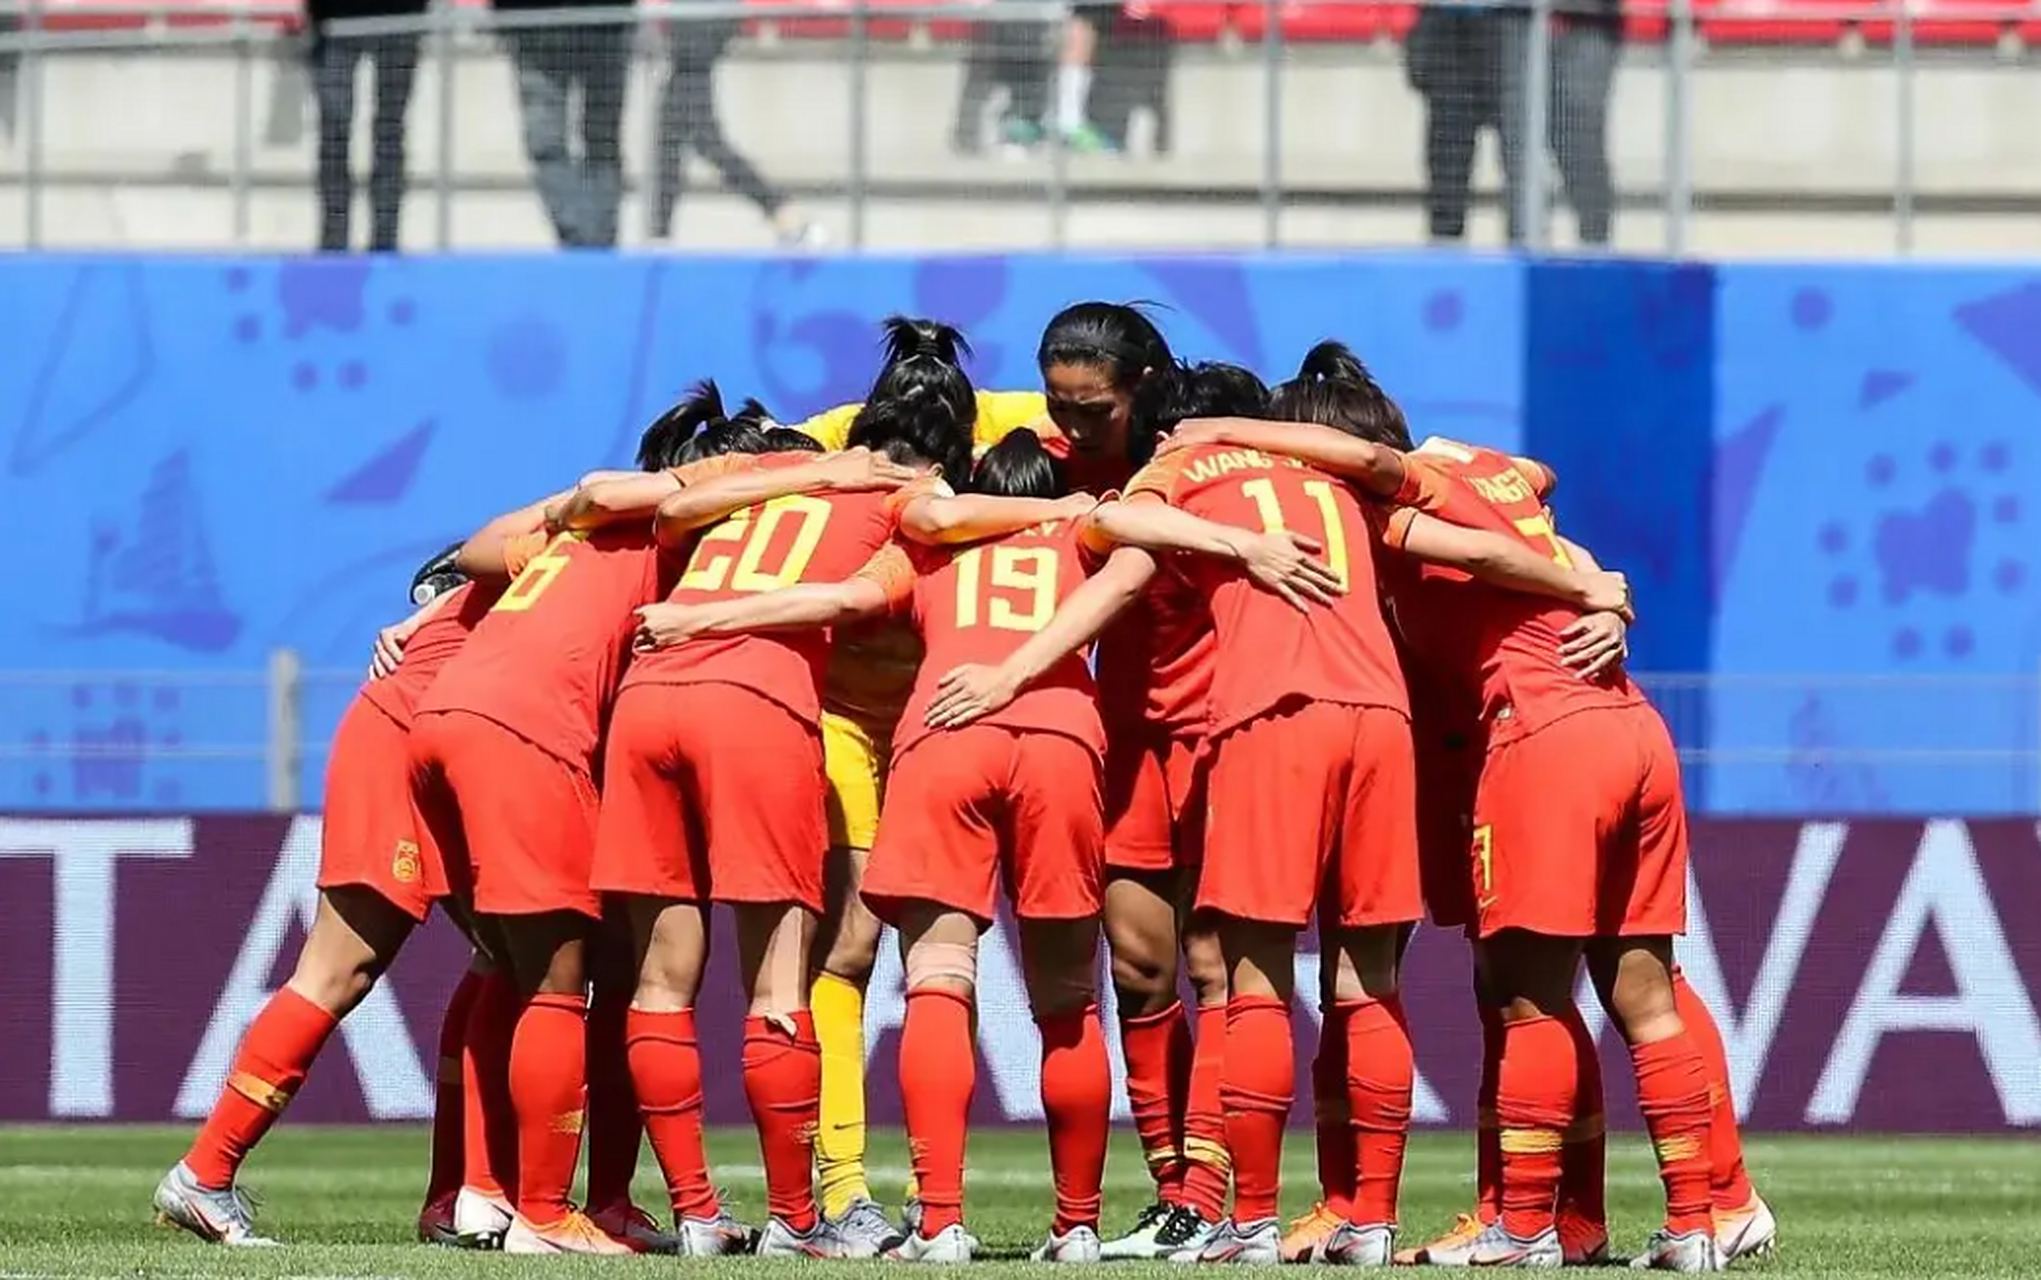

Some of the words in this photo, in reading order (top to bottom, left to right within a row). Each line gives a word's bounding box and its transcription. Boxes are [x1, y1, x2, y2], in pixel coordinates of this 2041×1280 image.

[493, 530, 588, 612] 6
[682, 493, 832, 592] 20
[1241, 478, 1350, 593] 11
[953, 545, 1059, 632] 19
[0, 818, 436, 1118] TA
